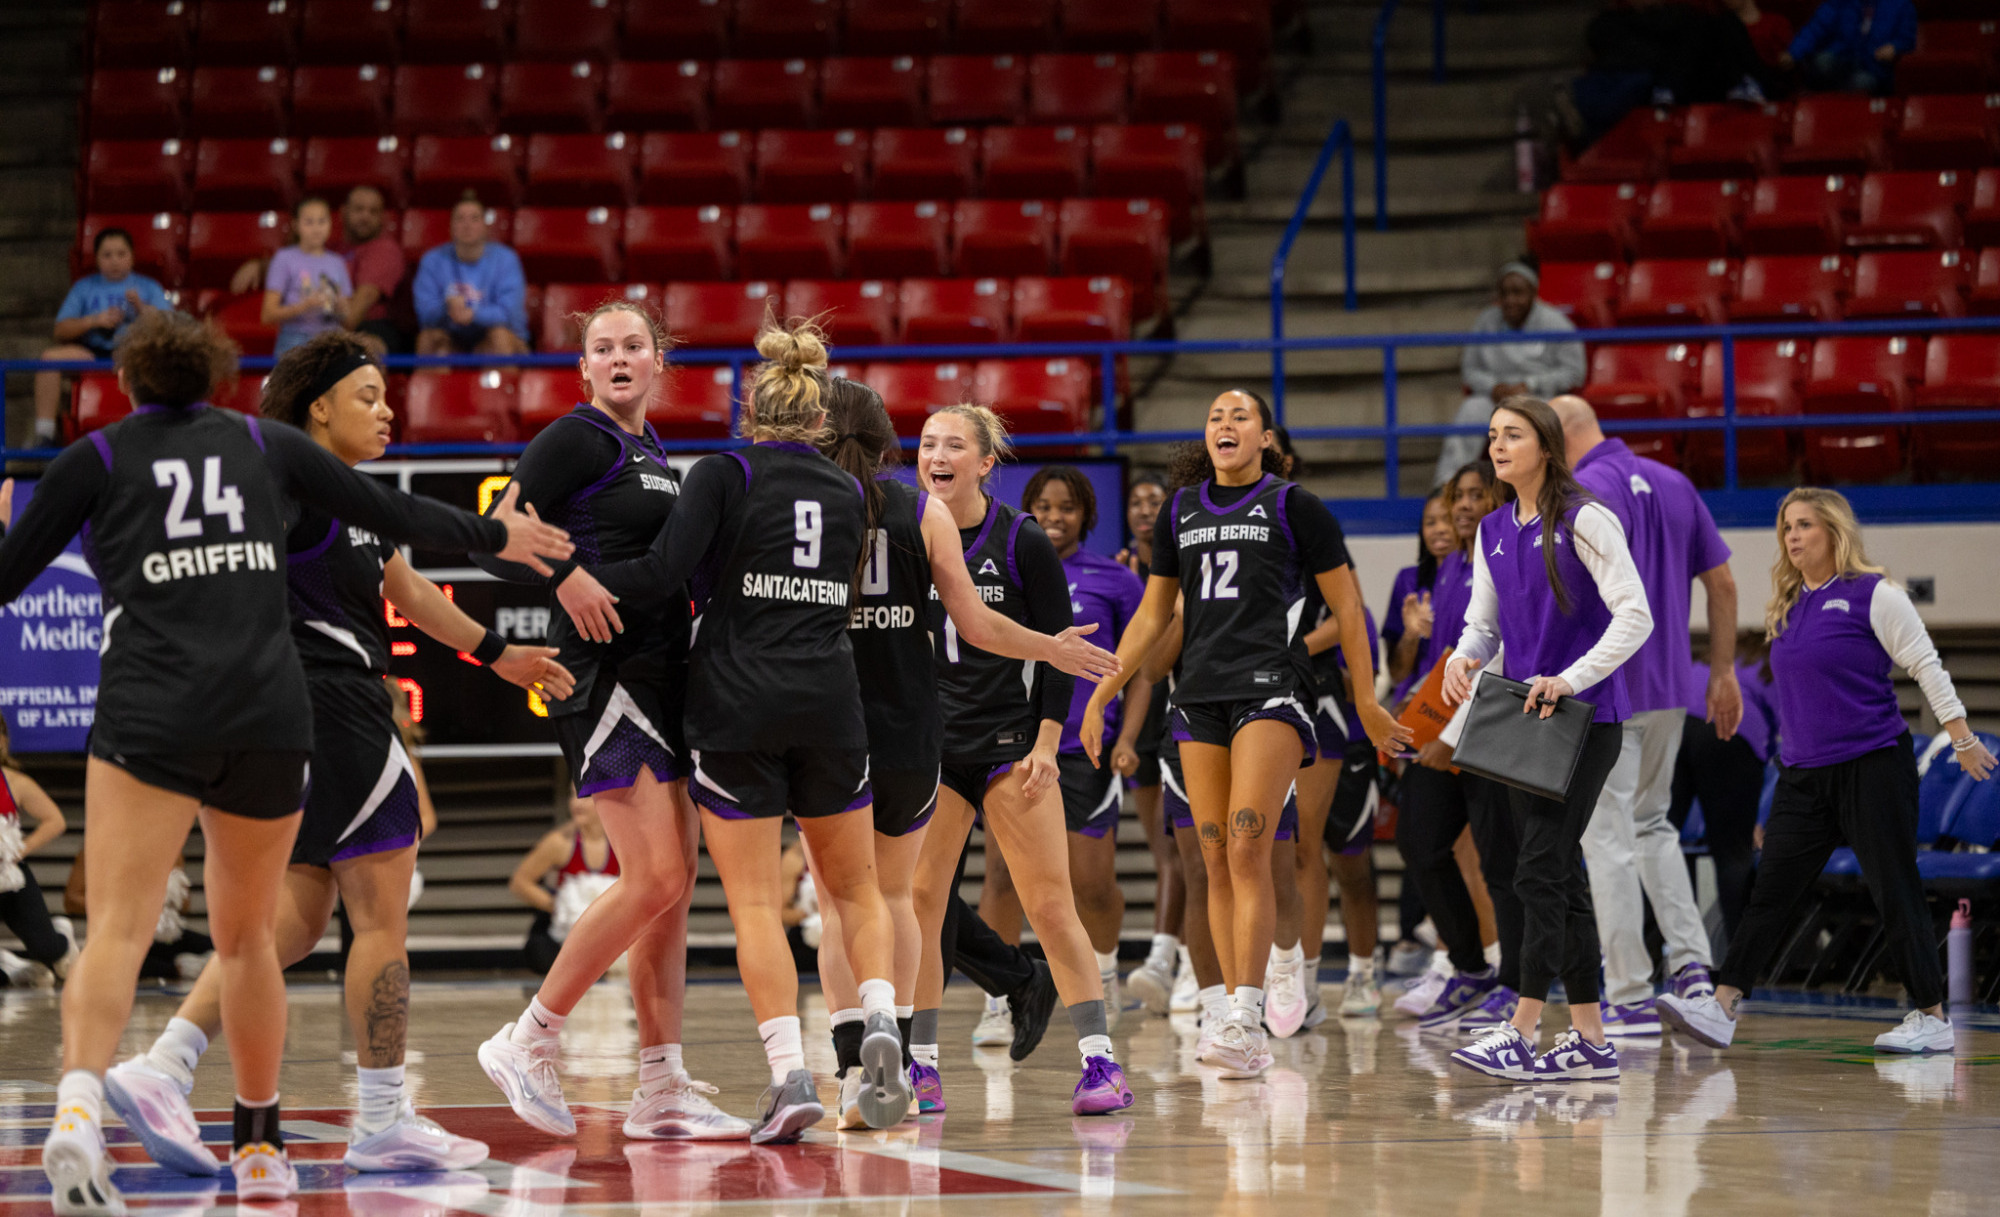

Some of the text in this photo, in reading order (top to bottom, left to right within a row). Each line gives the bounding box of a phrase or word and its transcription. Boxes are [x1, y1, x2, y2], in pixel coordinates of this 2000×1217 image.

[152, 456, 245, 539] 24
[640, 474, 675, 495] SUGAR
[793, 500, 822, 568] 9
[1179, 525, 1270, 549] SUGAR BEARS
[142, 541, 277, 583] GRIFFIN
[1201, 551, 1239, 600] 12
[742, 572, 849, 606] SANTACATERIN
[847, 605, 915, 630] EFORD
[17, 708, 42, 728] OF
